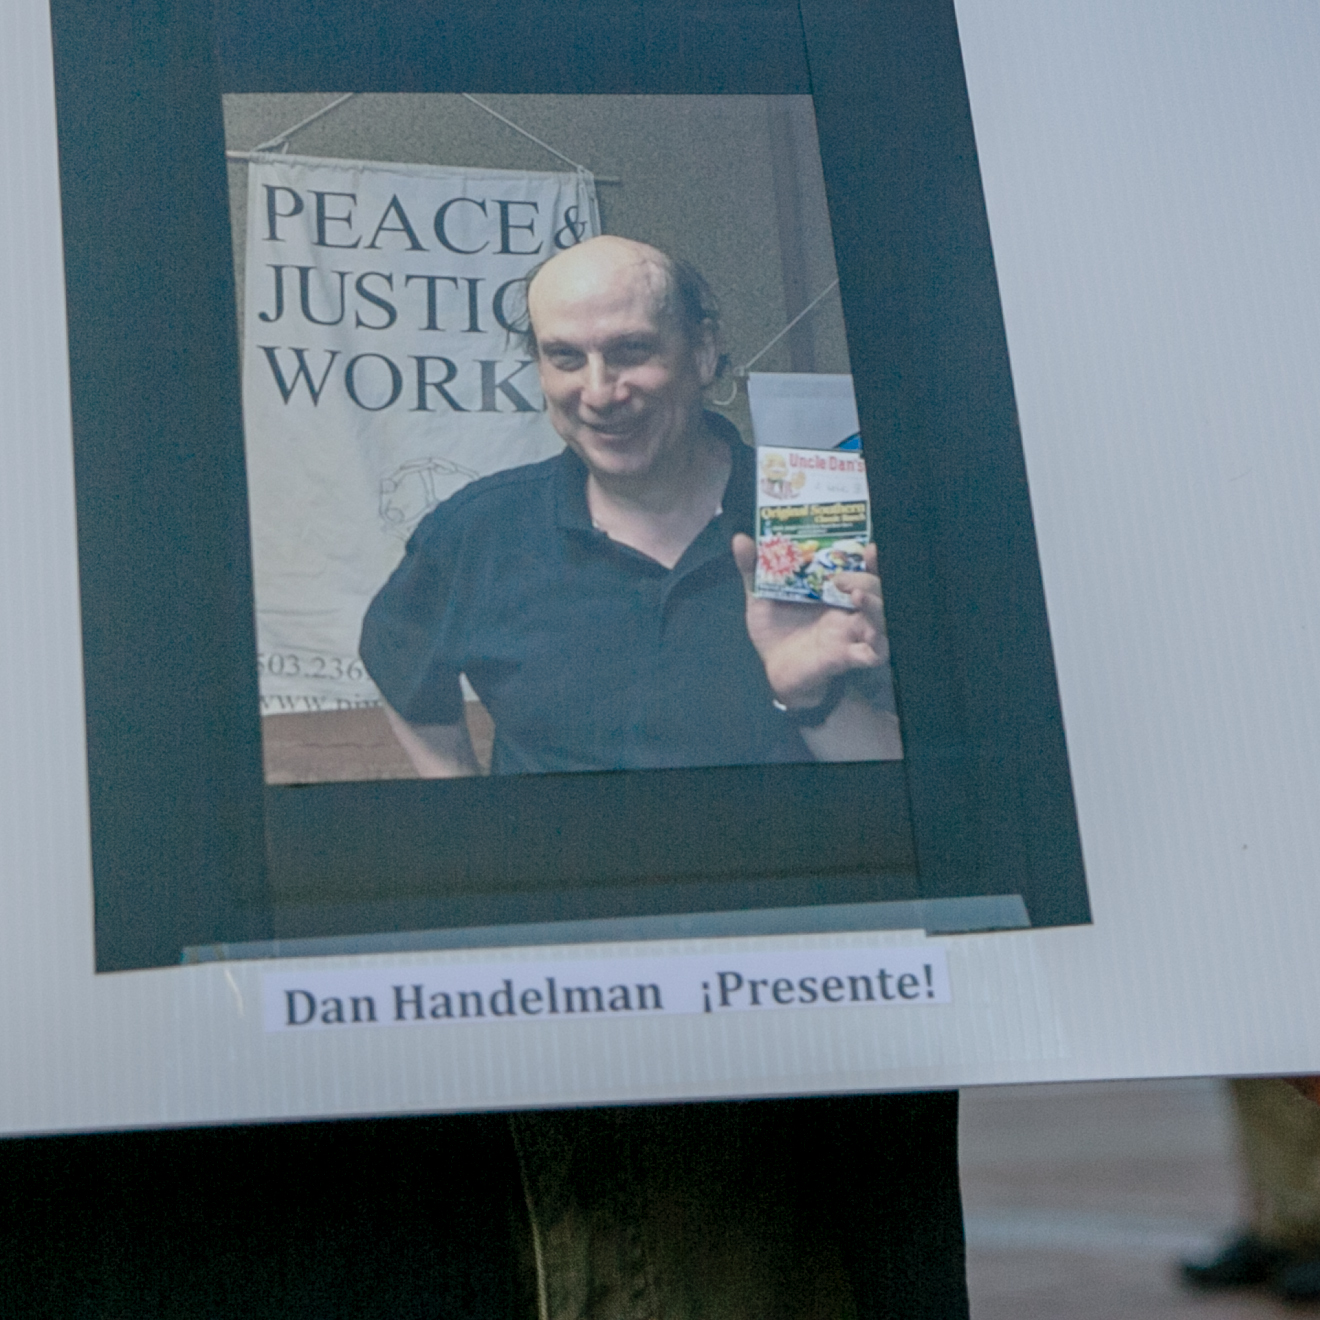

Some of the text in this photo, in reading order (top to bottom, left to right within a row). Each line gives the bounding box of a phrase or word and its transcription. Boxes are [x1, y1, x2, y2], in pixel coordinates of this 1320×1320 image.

[260, 183, 588, 256] PEACE &
[257, 263, 531, 335] JUSTIC
[257, 344, 548, 414] WORK
[788, 452, 866, 473] Uncle Dan's
[285, 963, 934, 1026] Dan Handelman ¡Presente!
